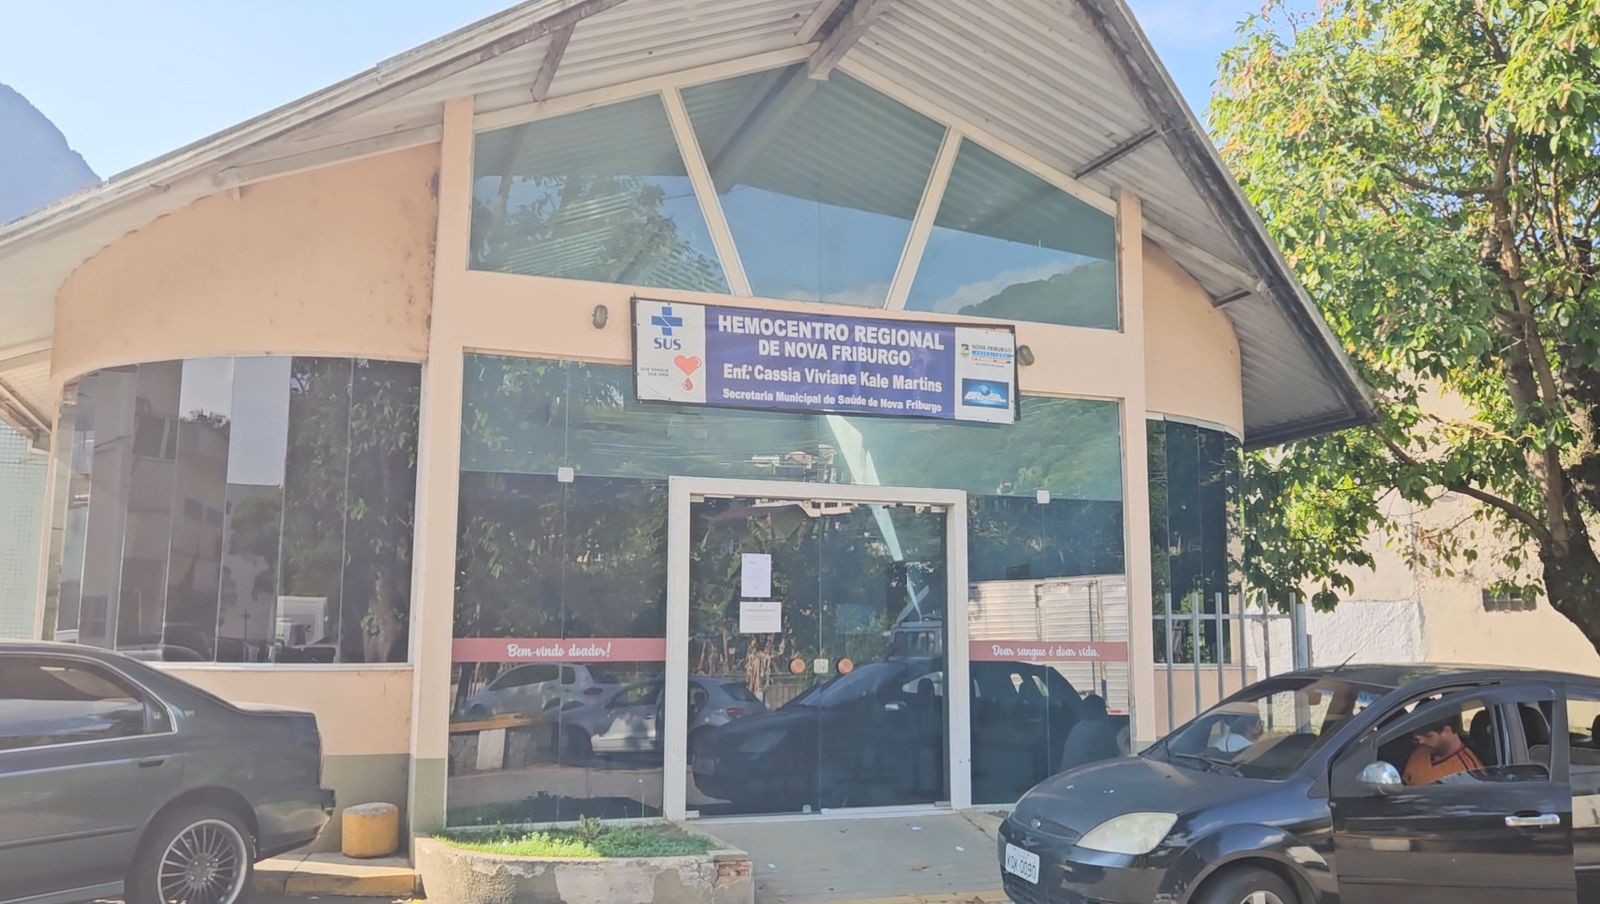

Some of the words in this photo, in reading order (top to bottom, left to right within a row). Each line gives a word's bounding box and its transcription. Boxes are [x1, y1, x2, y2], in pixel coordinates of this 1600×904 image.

[653, 337, 682, 351] SUS
[718, 314, 849, 342] HEMOCENTRO
[854, 325, 945, 350] REGIONAL
[758, 339, 780, 357] DE
[784, 341, 828, 360] NOVA
[832, 346, 911, 367] FRIBURGO
[753, 364, 801, 383] Cassia
[805, 367, 857, 386] Viviane
[860, 372, 889, 389] Kale
[892, 374, 943, 393] Martins
[723, 388, 774, 401] Secretaria
[775, 391, 822, 405] Municipal
[823, 394, 836, 405] de
[837, 394, 867, 406] Saúde
[868, 396, 878, 407] de
[880, 397, 904, 409] Nova
[905, 399, 943, 414] Friburgo
[506, 643, 566, 658] Bem-vindo
[568, 642, 612, 658] doador!
[991, 644, 1015, 657] Doar
[1016, 647, 1047, 660] sangue
[1048, 646, 1054, 657] é
[1056, 645, 1076, 657] doar
